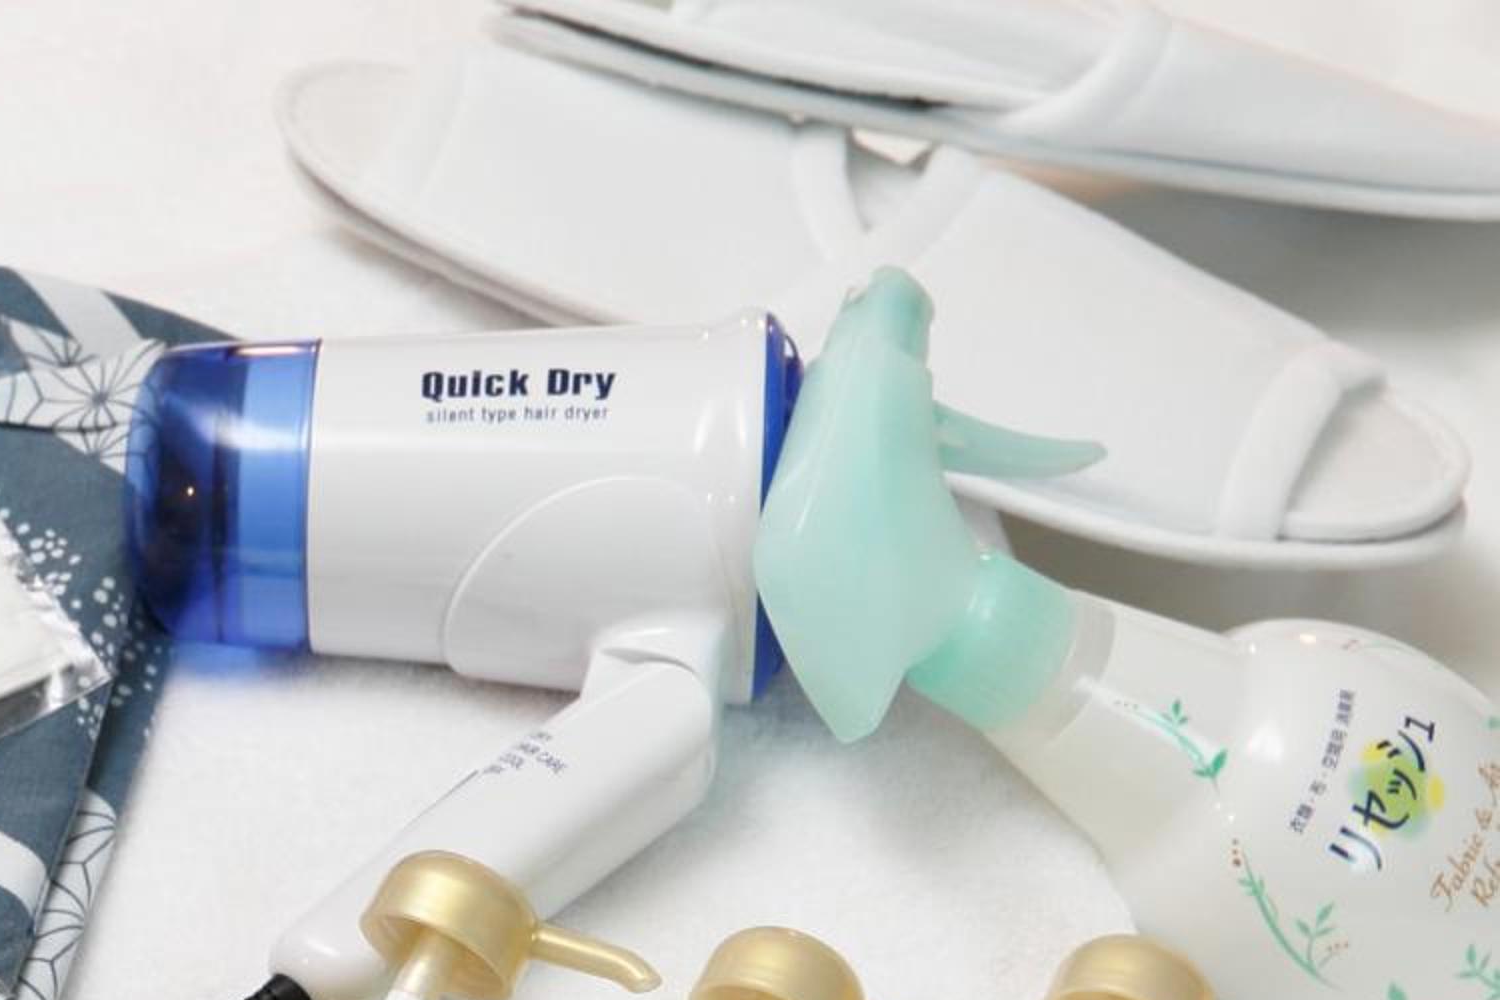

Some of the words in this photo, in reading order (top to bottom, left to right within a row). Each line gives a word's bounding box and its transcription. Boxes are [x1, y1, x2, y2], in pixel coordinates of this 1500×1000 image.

[421, 369, 529, 402] Quick
[547, 367, 616, 400] Dry
[426, 407, 475, 423] silent
[481, 406, 518, 424] type
[523, 405, 558, 421] hair
[564, 404, 609, 423] dryer
